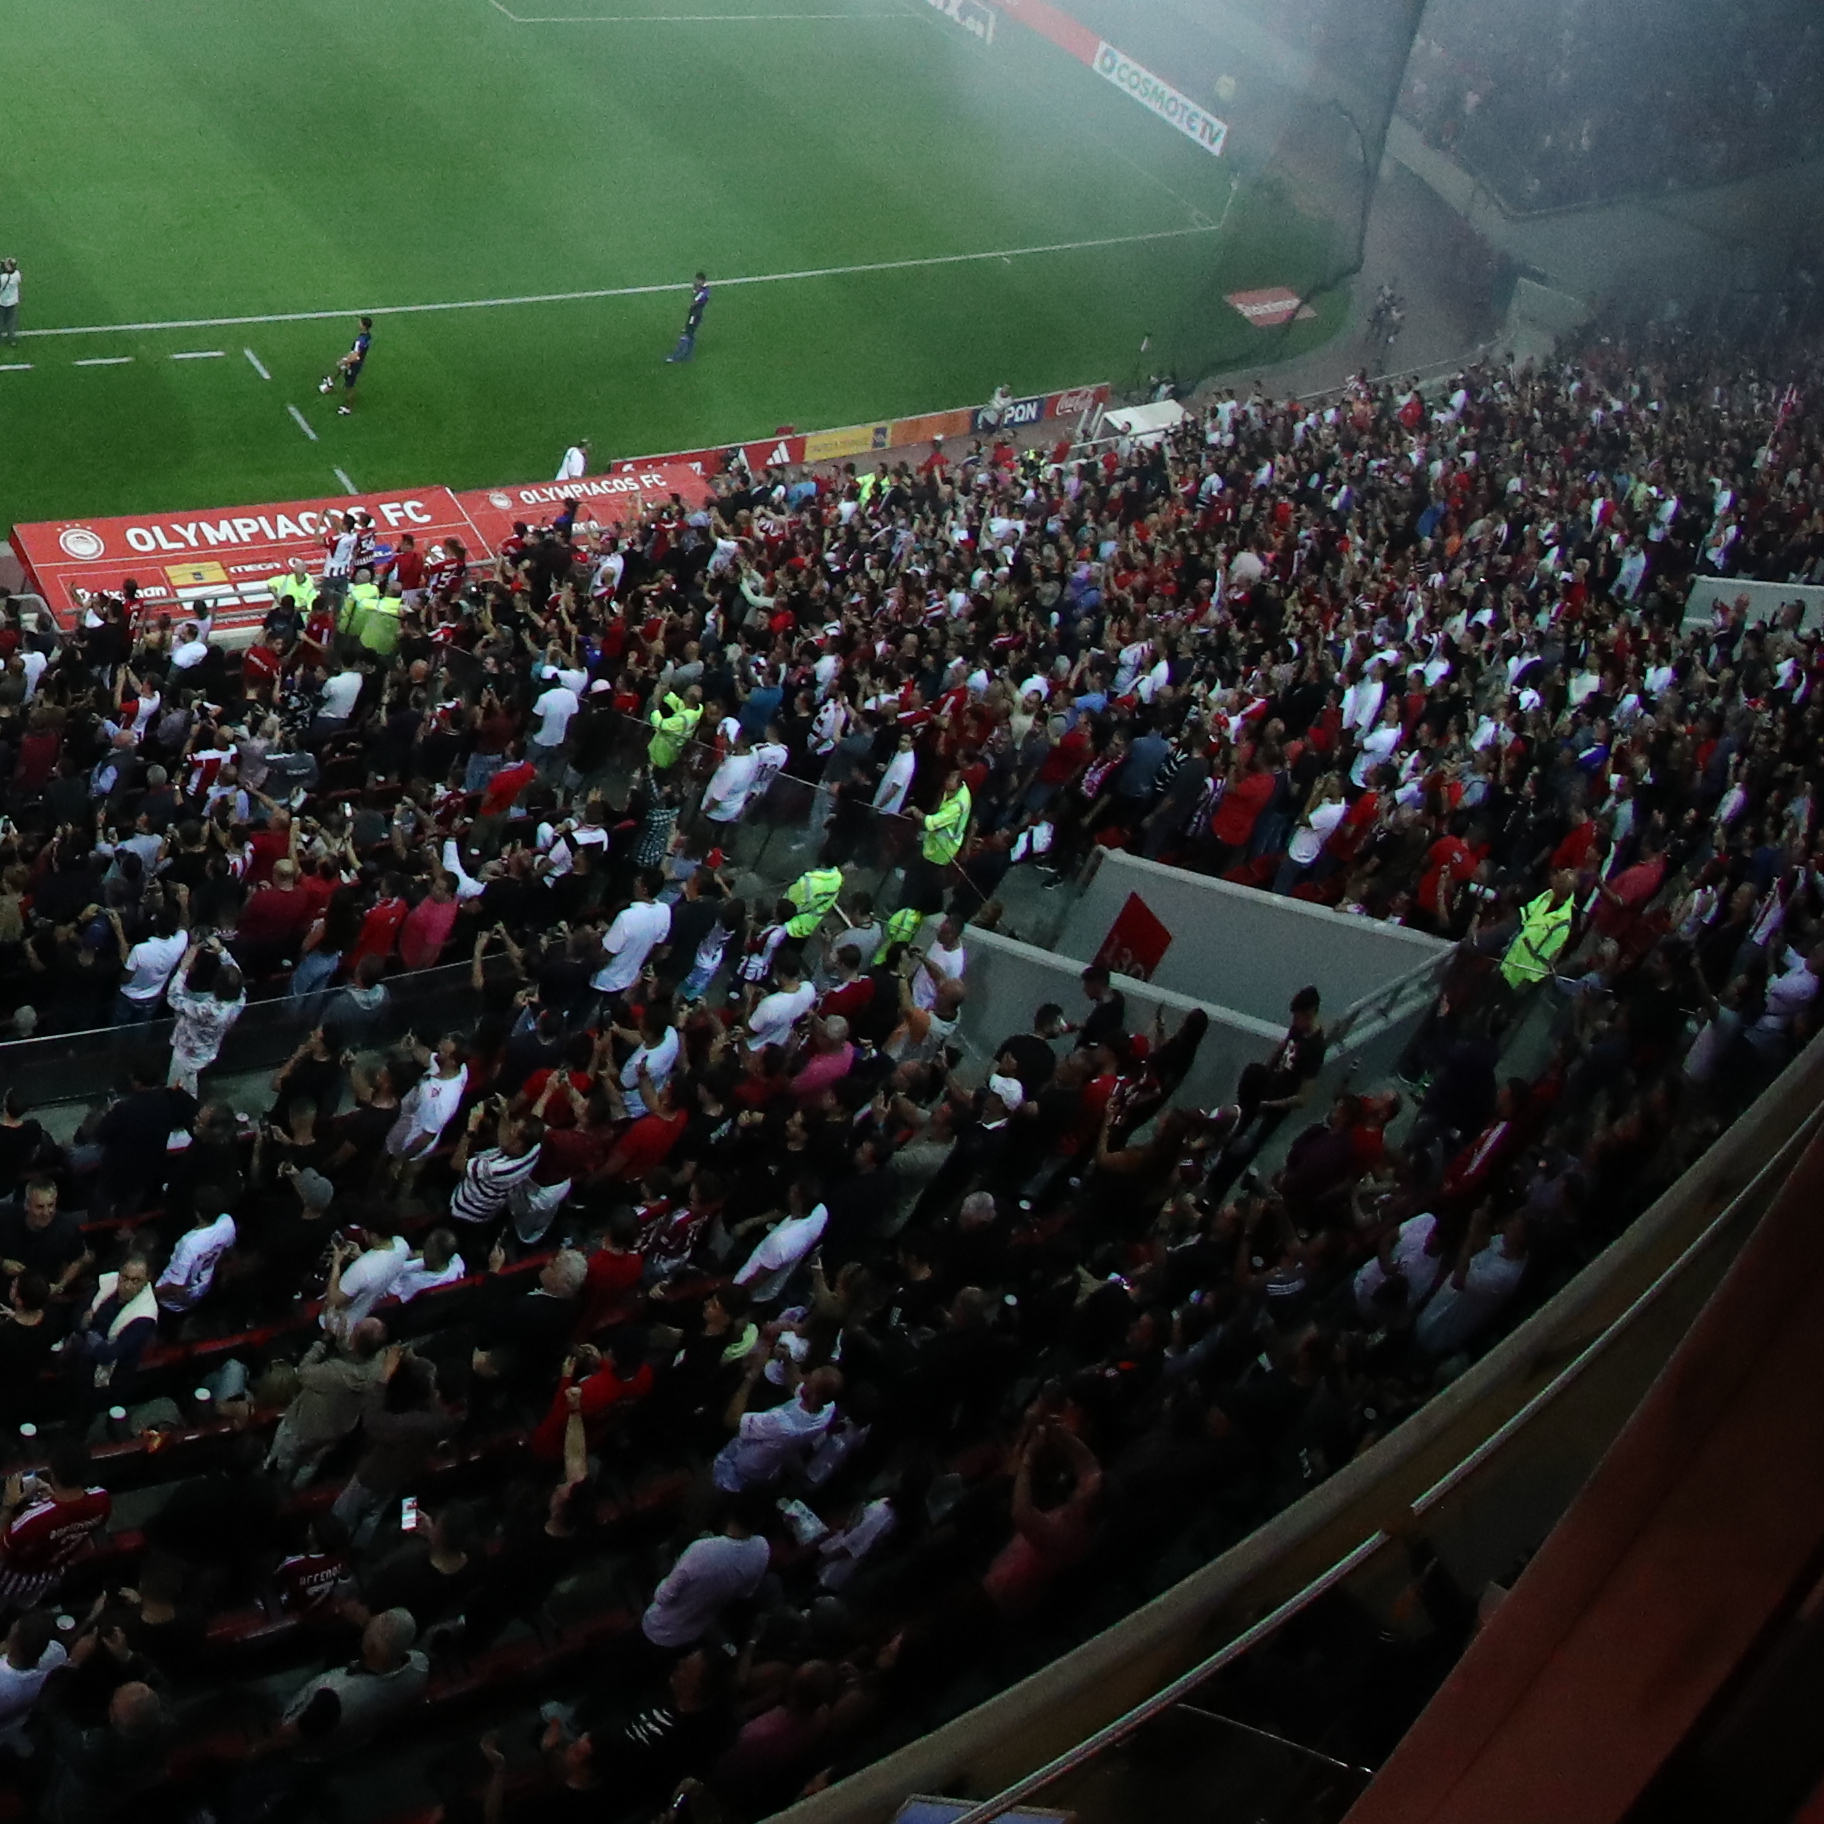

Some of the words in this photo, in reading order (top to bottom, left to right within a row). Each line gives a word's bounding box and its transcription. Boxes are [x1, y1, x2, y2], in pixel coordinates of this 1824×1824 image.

[1116, 63, 1199, 132] COSMOTE
[1199, 116, 1222, 146] TV
[1004, 402, 1038, 425] ΡΩΝ
[519, 478, 640, 505] OLYMPIACOS
[640, 473, 667, 488] FC
[379, 501, 432, 527] FC
[305, 1580, 334, 1609] 7
